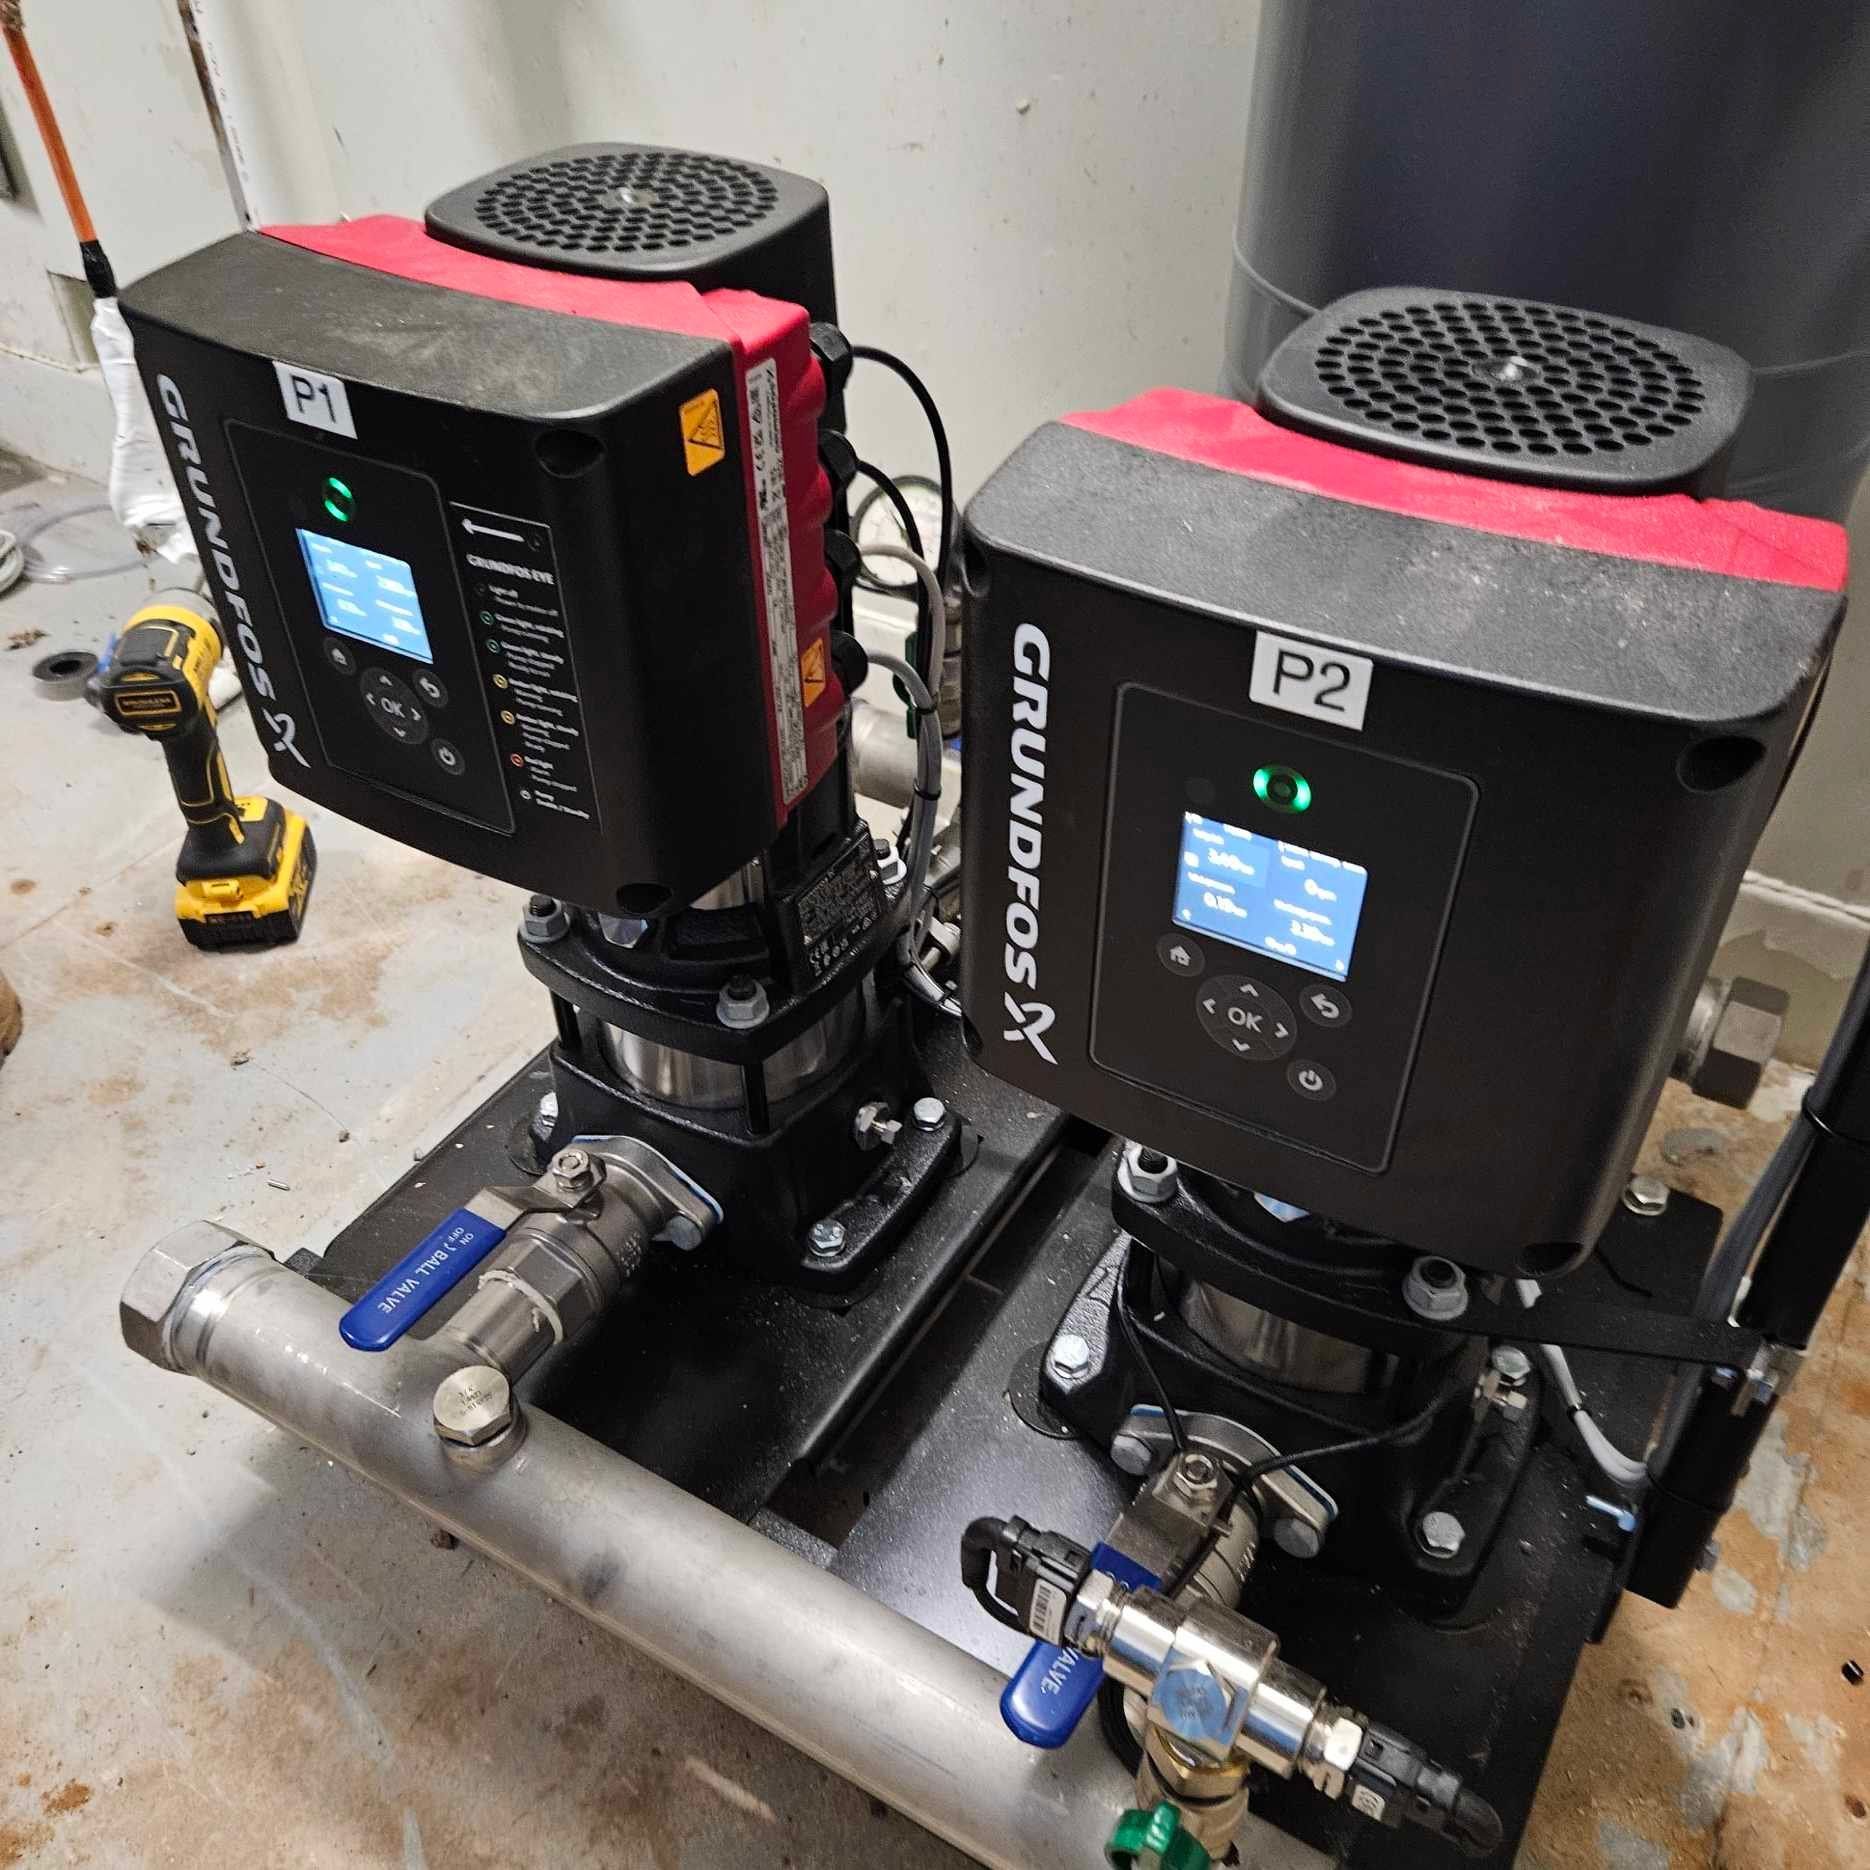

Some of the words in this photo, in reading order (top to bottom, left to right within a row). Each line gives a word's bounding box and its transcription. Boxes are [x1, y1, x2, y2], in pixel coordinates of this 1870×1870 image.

[290, 374, 336, 424] P1
[157, 374, 277, 701] GRUNDFOS
[1273, 648, 1351, 712] P2
[381, 697, 406, 719] OK
[1004, 622, 1051, 990] GRUNDFOS
[1228, 1007, 1263, 1033] OK
[447, 1226, 465, 1243] OFF
[459, 1232, 474, 1246] ON
[415, 1249, 449, 1276] BALL
[377, 1278, 420, 1314] VALVE
